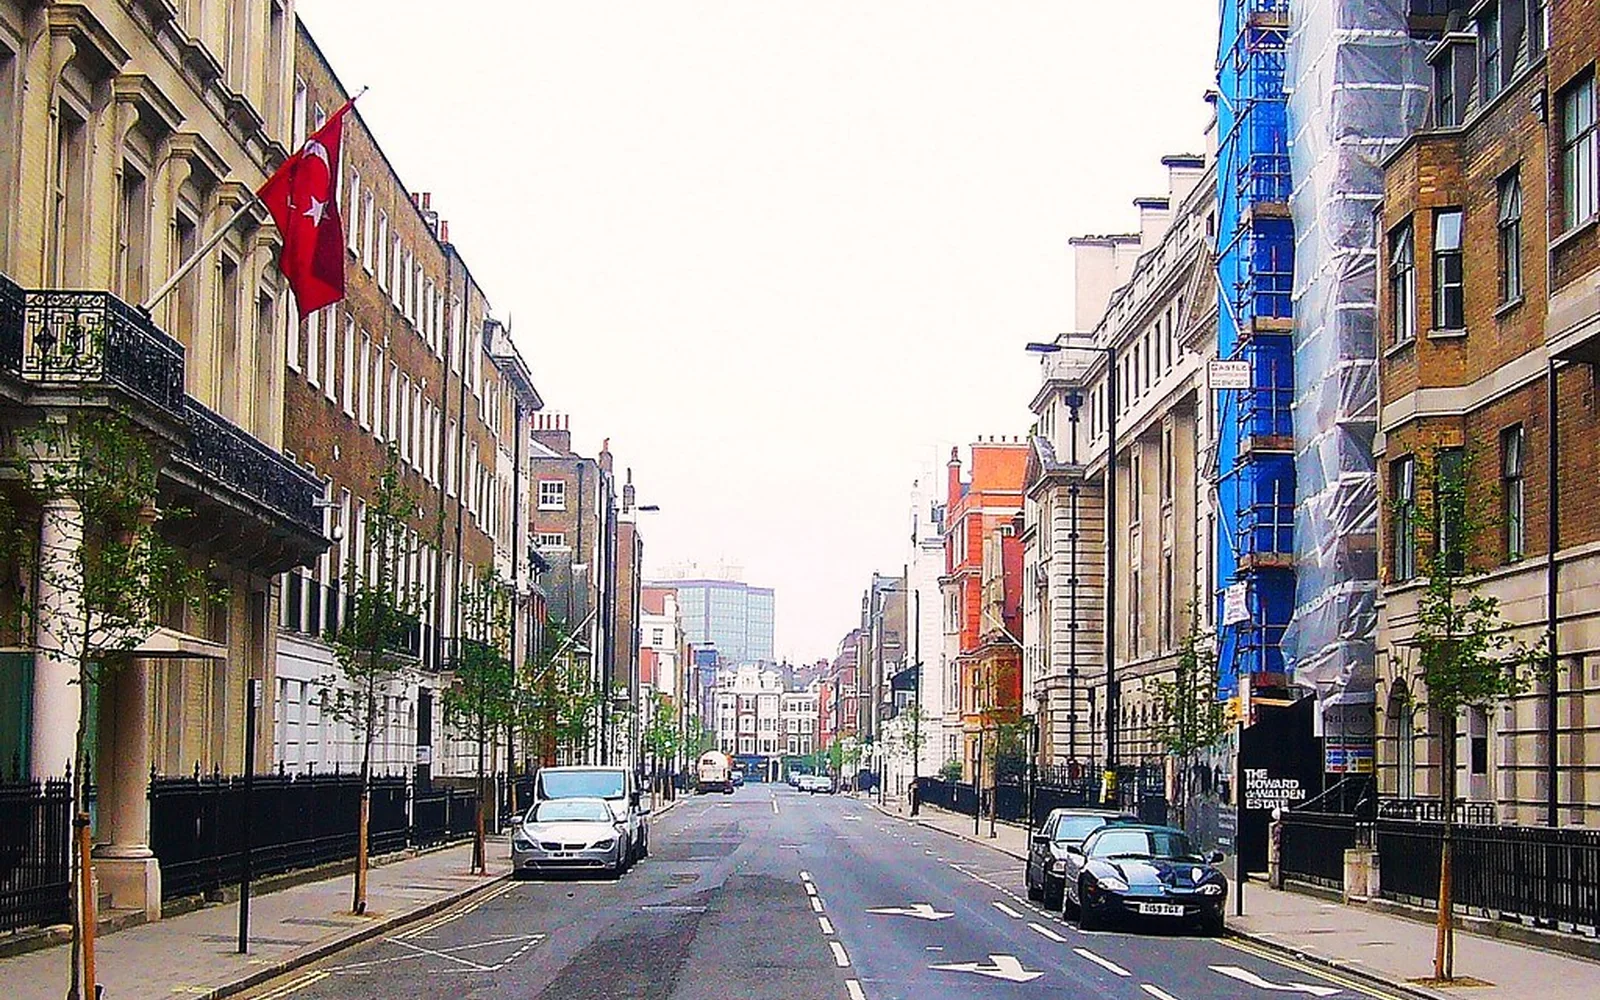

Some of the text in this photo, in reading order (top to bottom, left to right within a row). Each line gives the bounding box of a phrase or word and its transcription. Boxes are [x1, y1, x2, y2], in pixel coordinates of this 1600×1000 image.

[1244, 769, 1268, 779] THE
[1246, 779, 1299, 789] HOWARD
[1246, 799, 1289, 810] ESTATE
